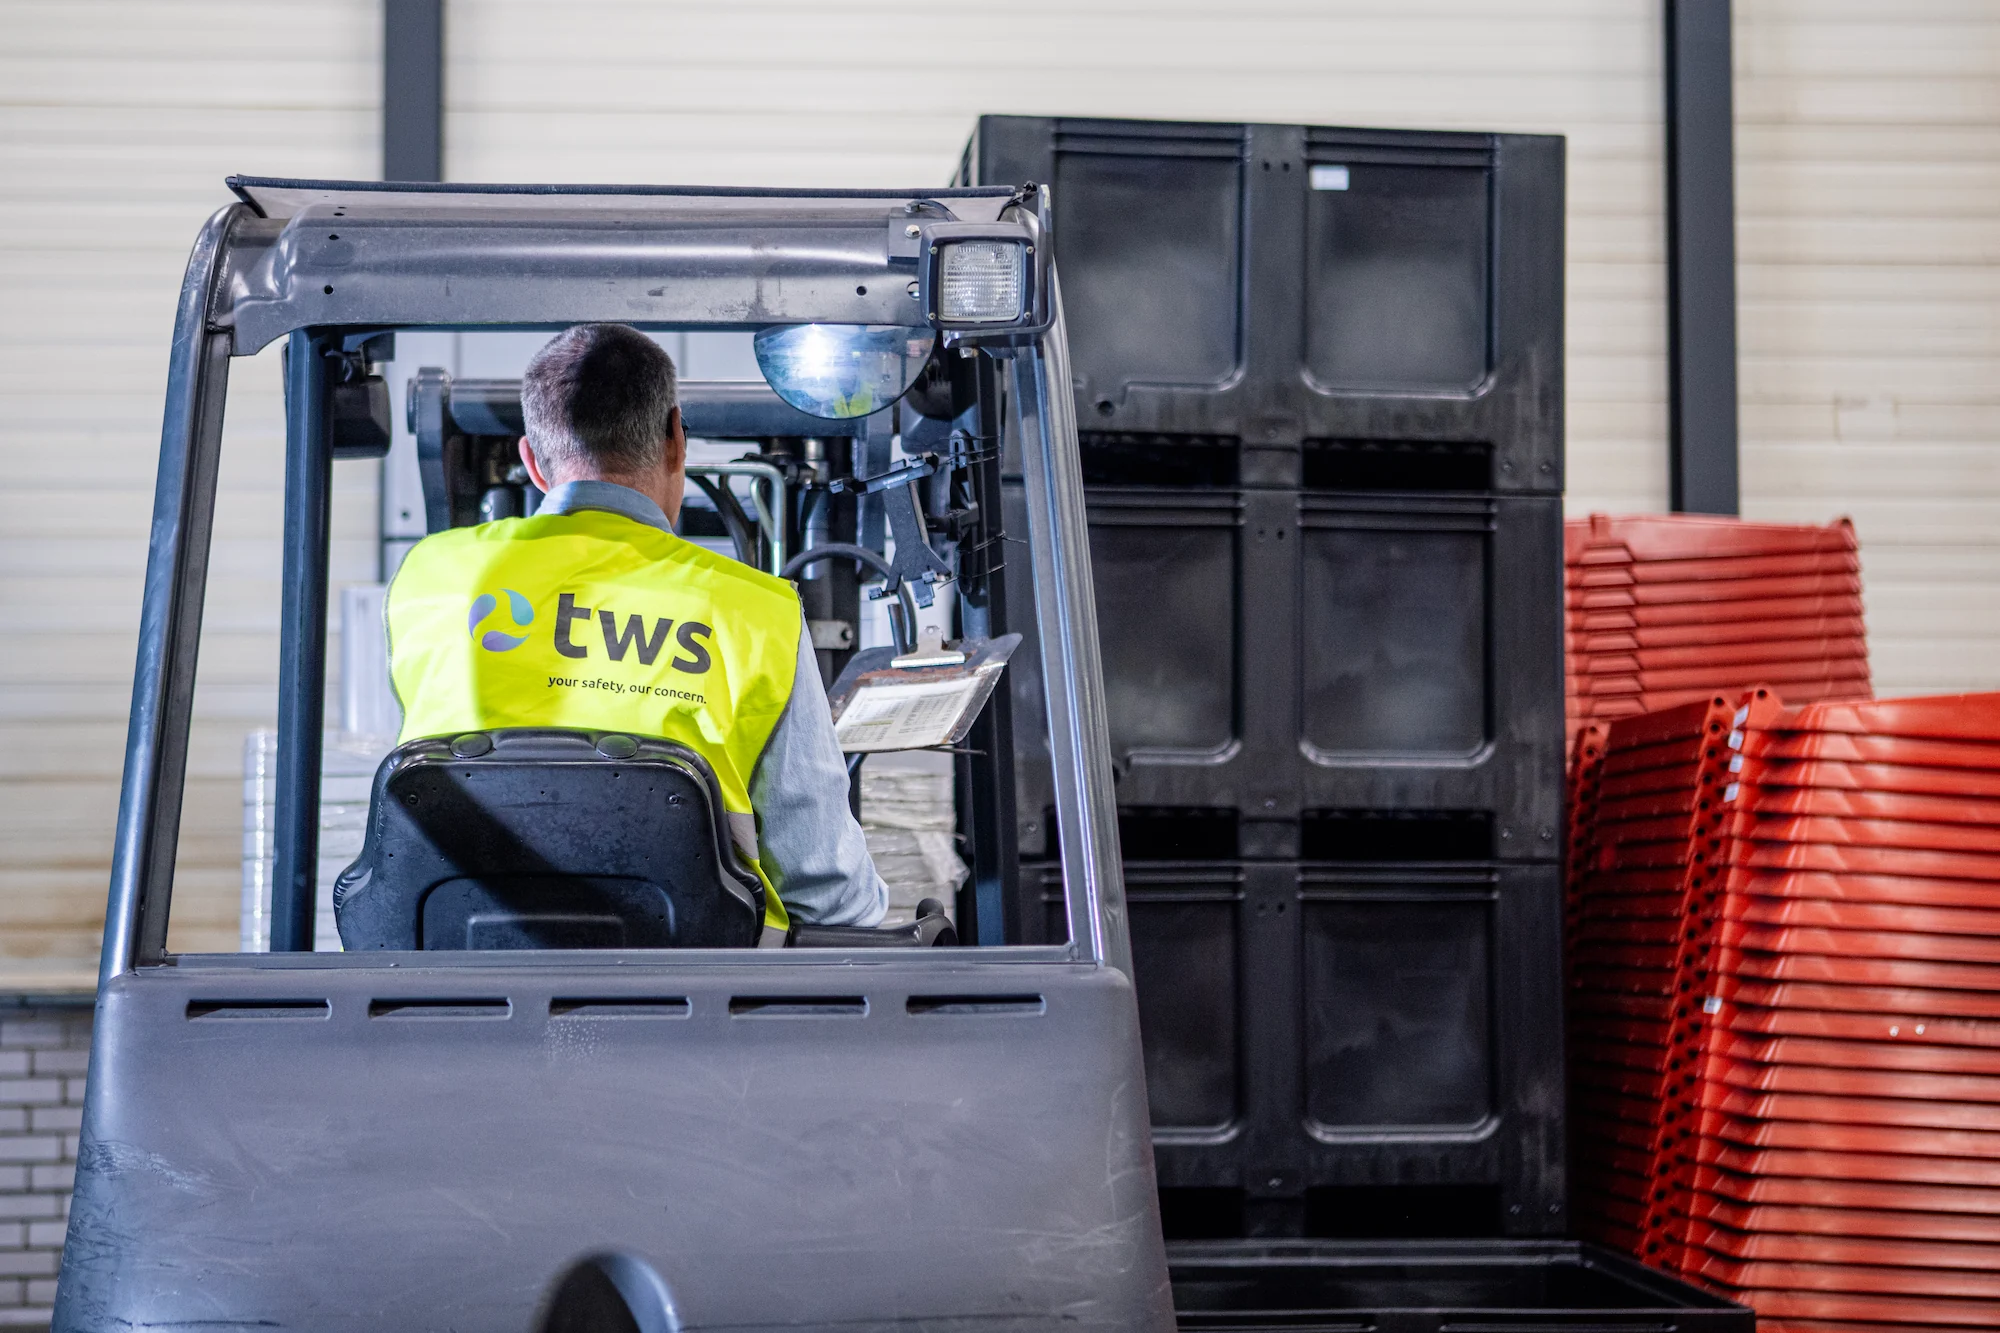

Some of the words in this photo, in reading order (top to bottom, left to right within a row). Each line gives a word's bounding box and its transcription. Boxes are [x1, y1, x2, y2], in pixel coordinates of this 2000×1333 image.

[554, 593, 712, 674] tws
[547, 676, 579, 688] your
[582, 677, 626, 694] safety,
[629, 684, 652, 695] our
[654, 686, 707, 704] concern.
